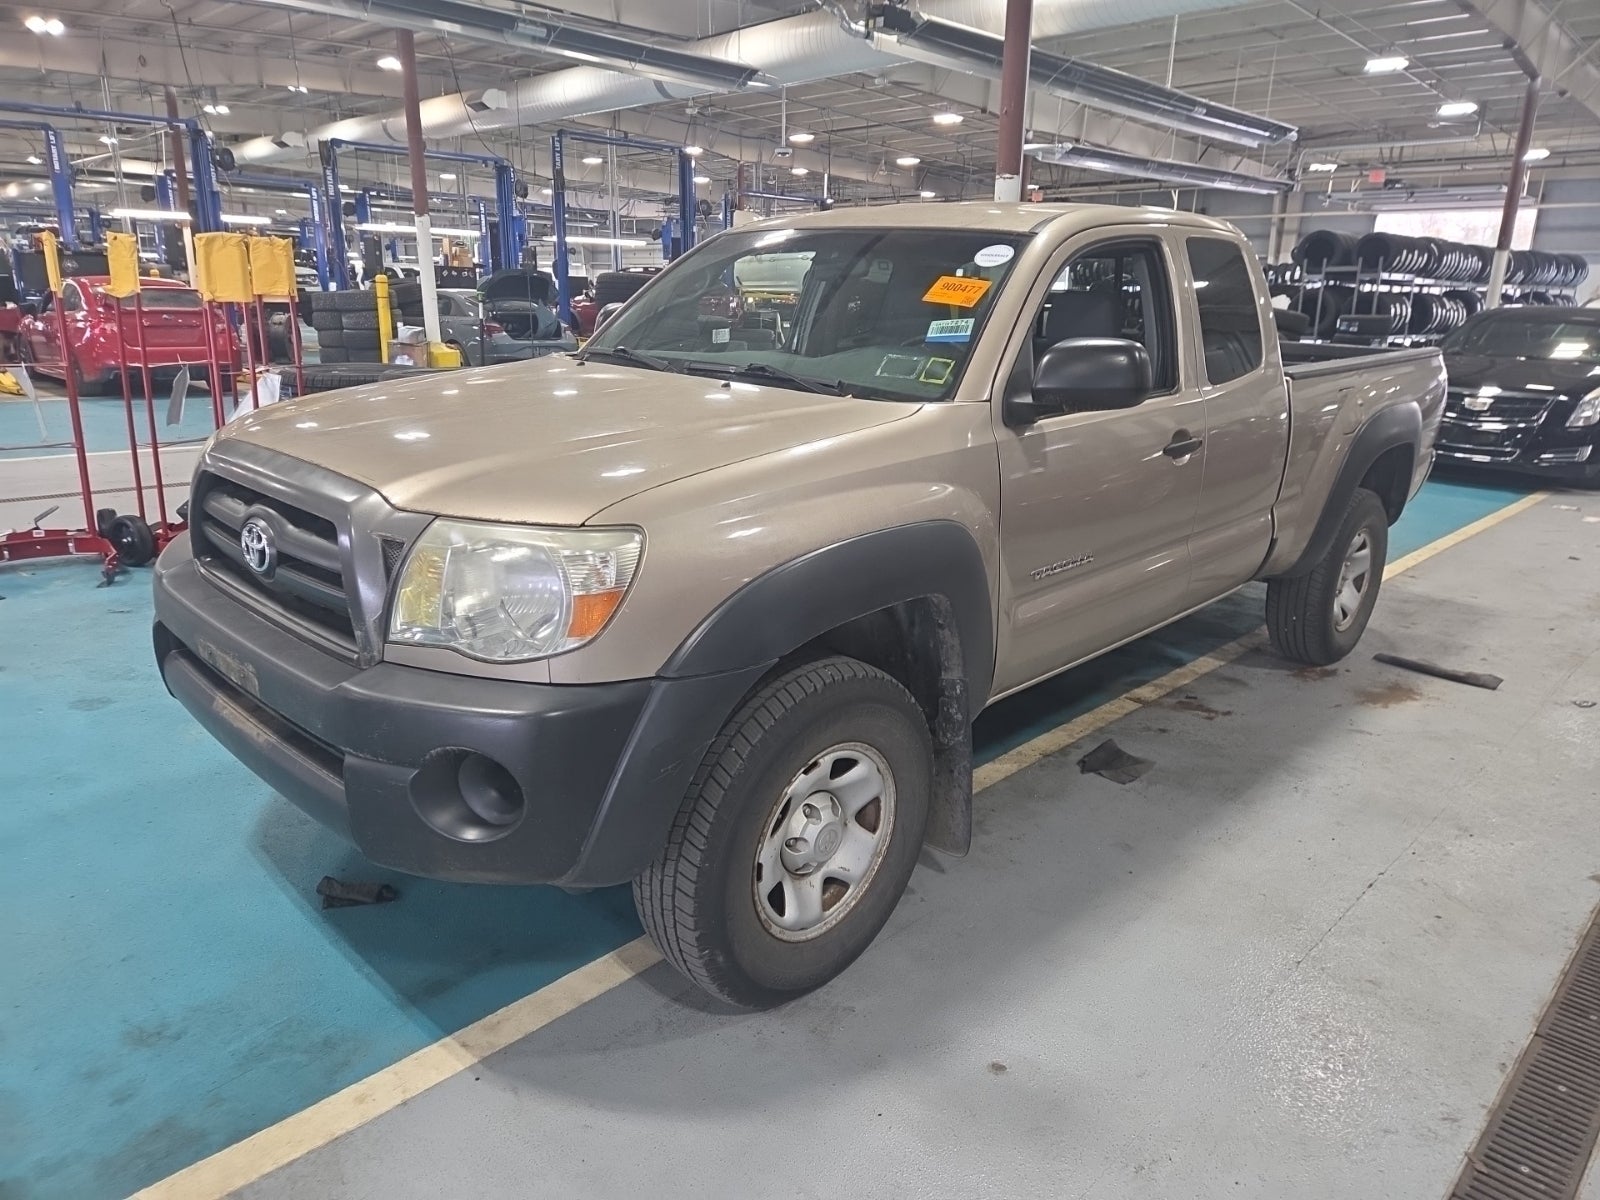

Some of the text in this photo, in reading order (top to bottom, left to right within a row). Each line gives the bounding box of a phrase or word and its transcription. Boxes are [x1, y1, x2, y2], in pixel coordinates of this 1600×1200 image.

[48, 130, 60, 170] ROTARY LIFT
[942, 282, 983, 295] 900477
